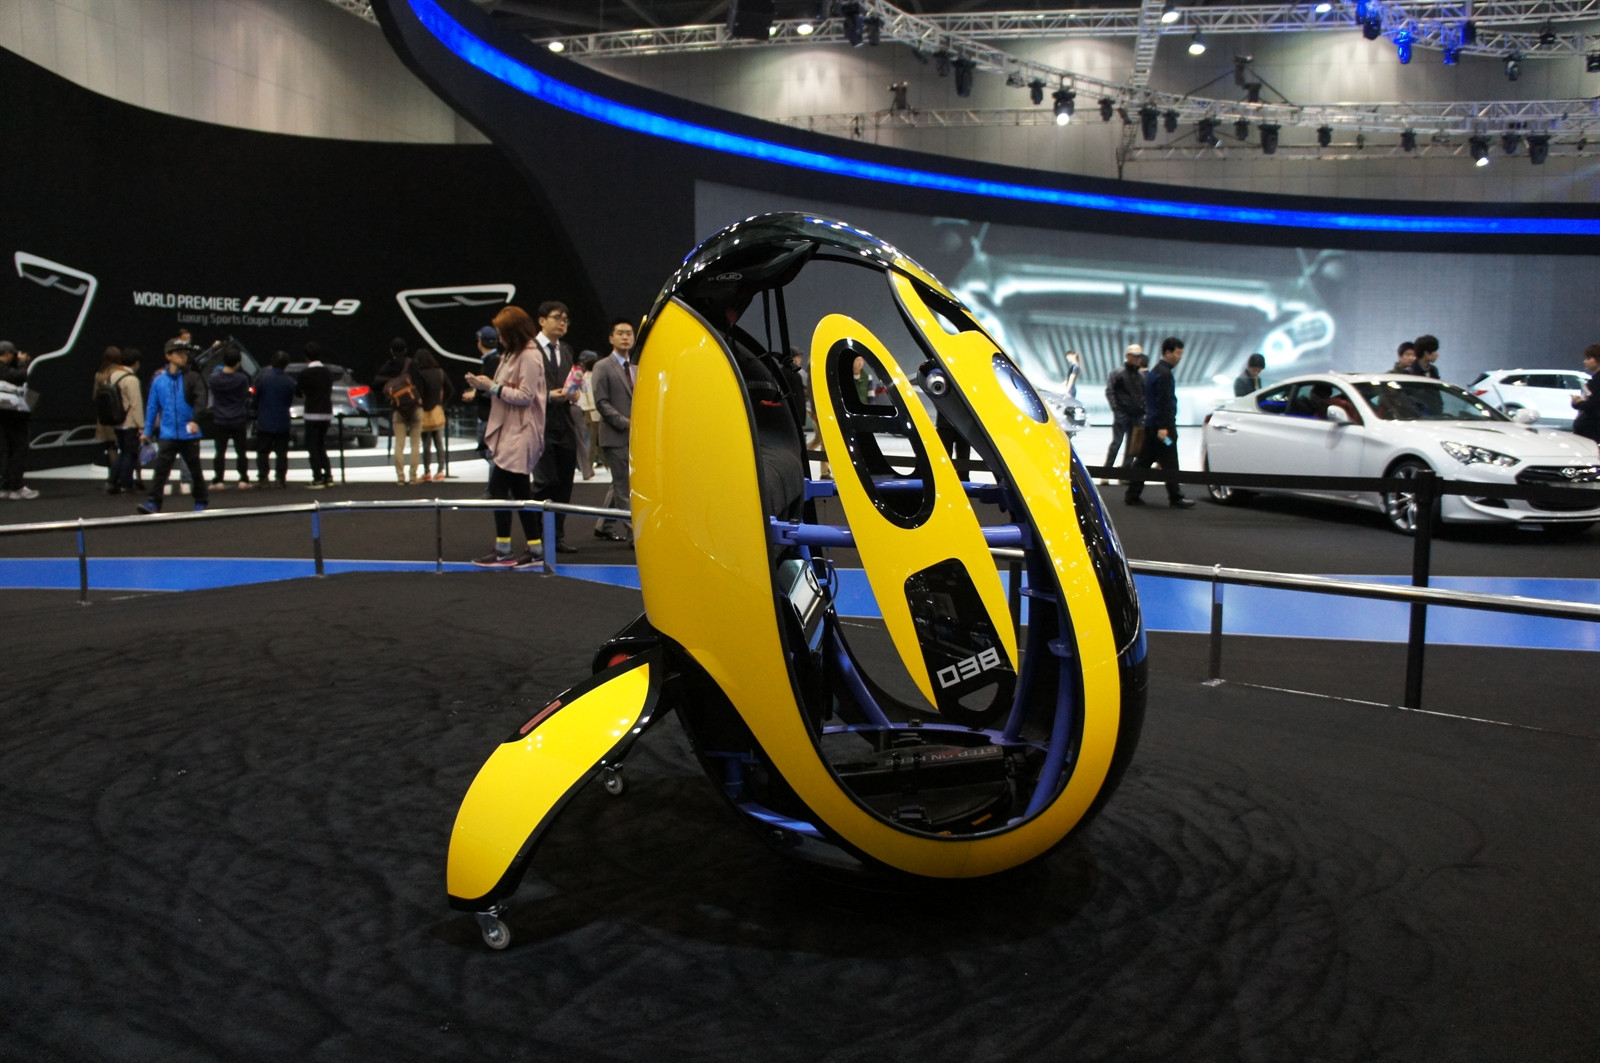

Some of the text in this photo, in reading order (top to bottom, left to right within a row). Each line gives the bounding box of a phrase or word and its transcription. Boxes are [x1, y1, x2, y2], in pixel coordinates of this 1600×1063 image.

[133, 291, 361, 315] WORLD PREMIERE HND-9
[177, 312, 309, 327] Luxury Sports Coupe Concept
[936, 646, 1001, 689] 038
[958, 747, 998, 757] STEP
